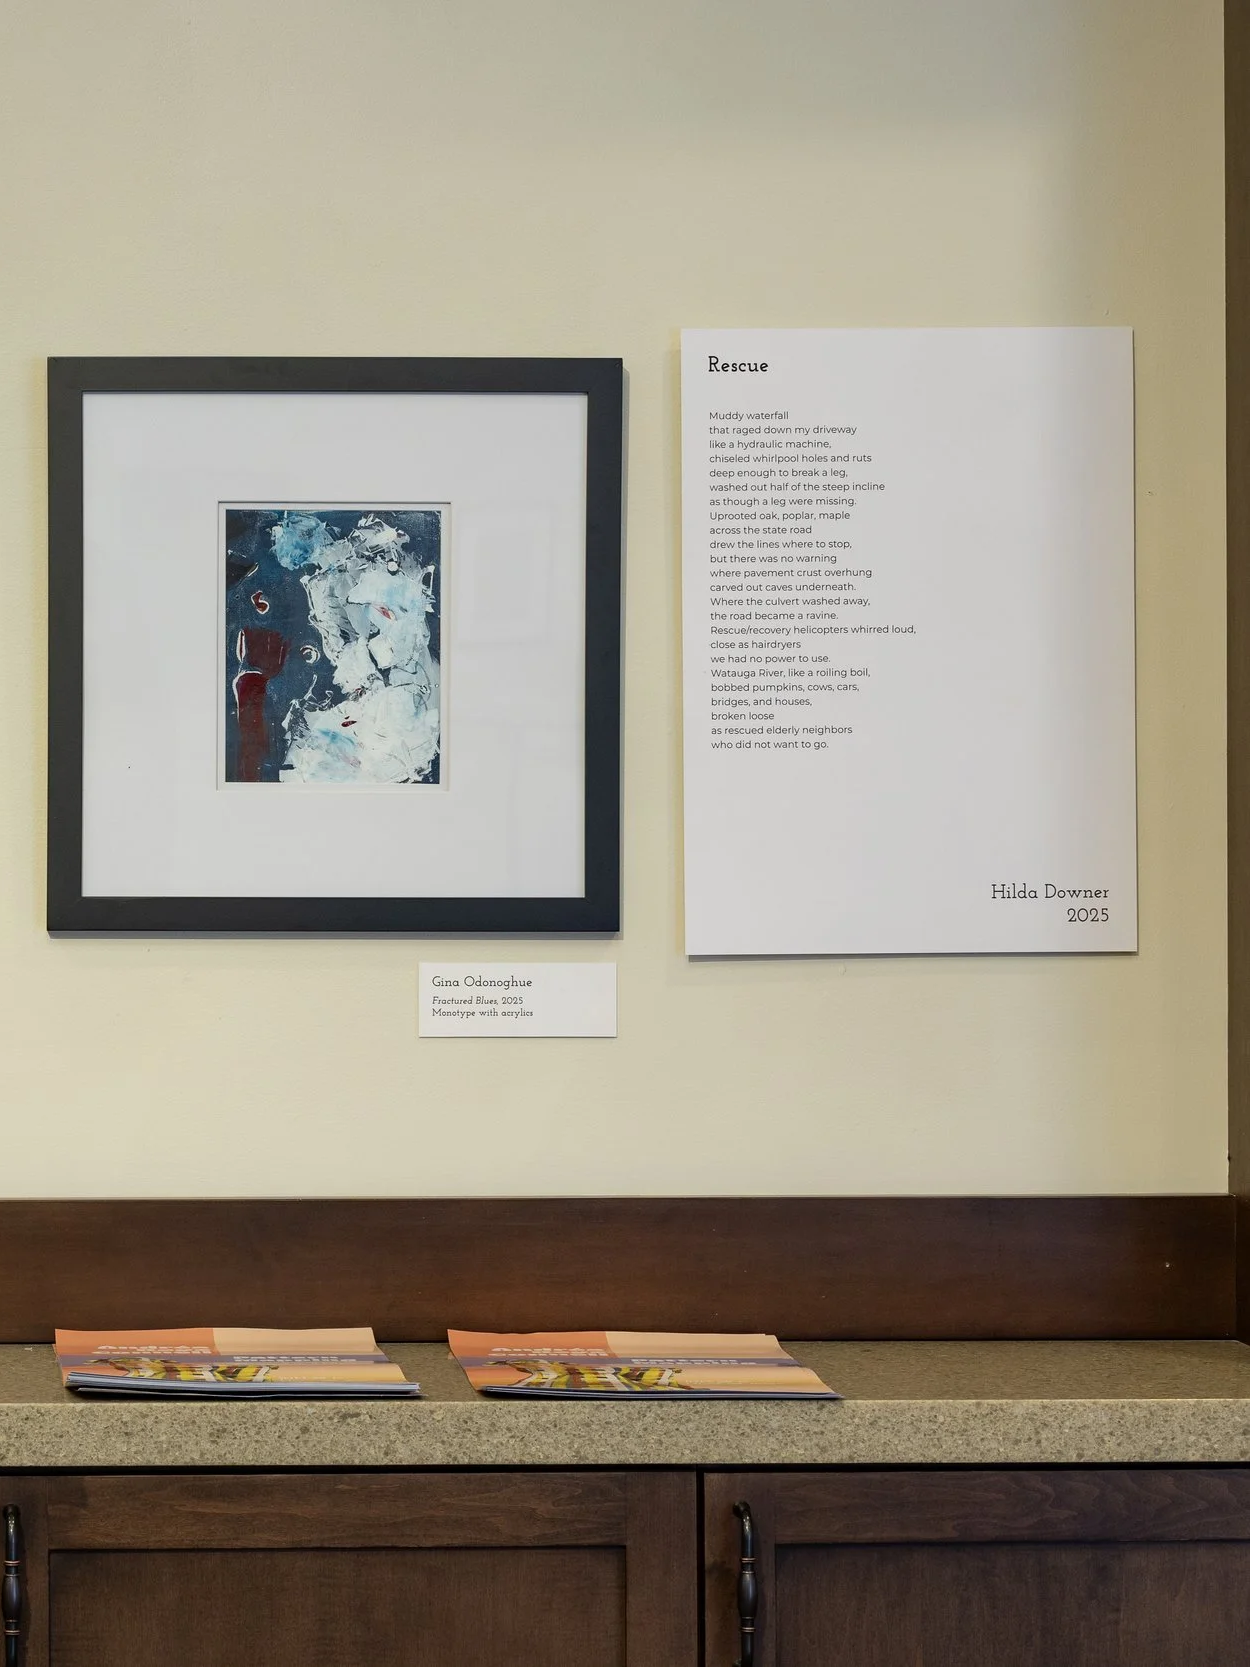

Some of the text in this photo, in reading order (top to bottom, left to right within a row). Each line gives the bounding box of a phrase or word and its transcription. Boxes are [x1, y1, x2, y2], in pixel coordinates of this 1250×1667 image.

[708, 356, 769, 373] Rescue
[710, 411, 789, 422] Muddy waterfall
[710, 425, 857, 436] that raged down my driveway
[710, 440, 727, 449] like
[738, 440, 783, 451] hydraulic
[786, 440, 832, 449] machine,
[709, 454, 872, 465] chiseled whirlpool holes and ruts
[710, 511, 850, 522] Uprooted oak, poplar, maple
[710, 569, 742, 578] where
[744, 570, 795, 579] pavement
[824, 568, 872, 579] overhung
[710, 583, 743, 592] carved
[746, 584, 763, 592] out
[796, 582, 856, 591] underneath.
[710, 597, 871, 607] Where the culvert washed away,
[711, 625, 916, 636] Rescue/recovery helicopters whirred loud,
[711, 640, 736, 649] close
[752, 640, 801, 651] hairdryers
[711, 669, 756, 679] Watauga
[759, 669, 786, 678] River,
[788, 668, 805, 677] like
[816, 668, 847, 679] roiling
[850, 668, 871, 678] boil,
[711, 683, 859, 693] bobbed pumpkins, cows, cars,
[712, 697, 812, 708] bridges, and houses,
[712, 712, 775, 721] broken loose
[725, 726, 764, 735] rescued
[766, 726, 800, 736] elderly
[802, 725, 853, 736] neighbors
[991, 883, 1110, 899] Hilda Downer
[1067, 908, 1109, 923] 2025
[432, 975, 533, 991] Gina Odonoghue
[432, 996, 523, 1005] Fractured Blues, 2025
[432, 1008, 533, 1019] Monotype with acrylics
